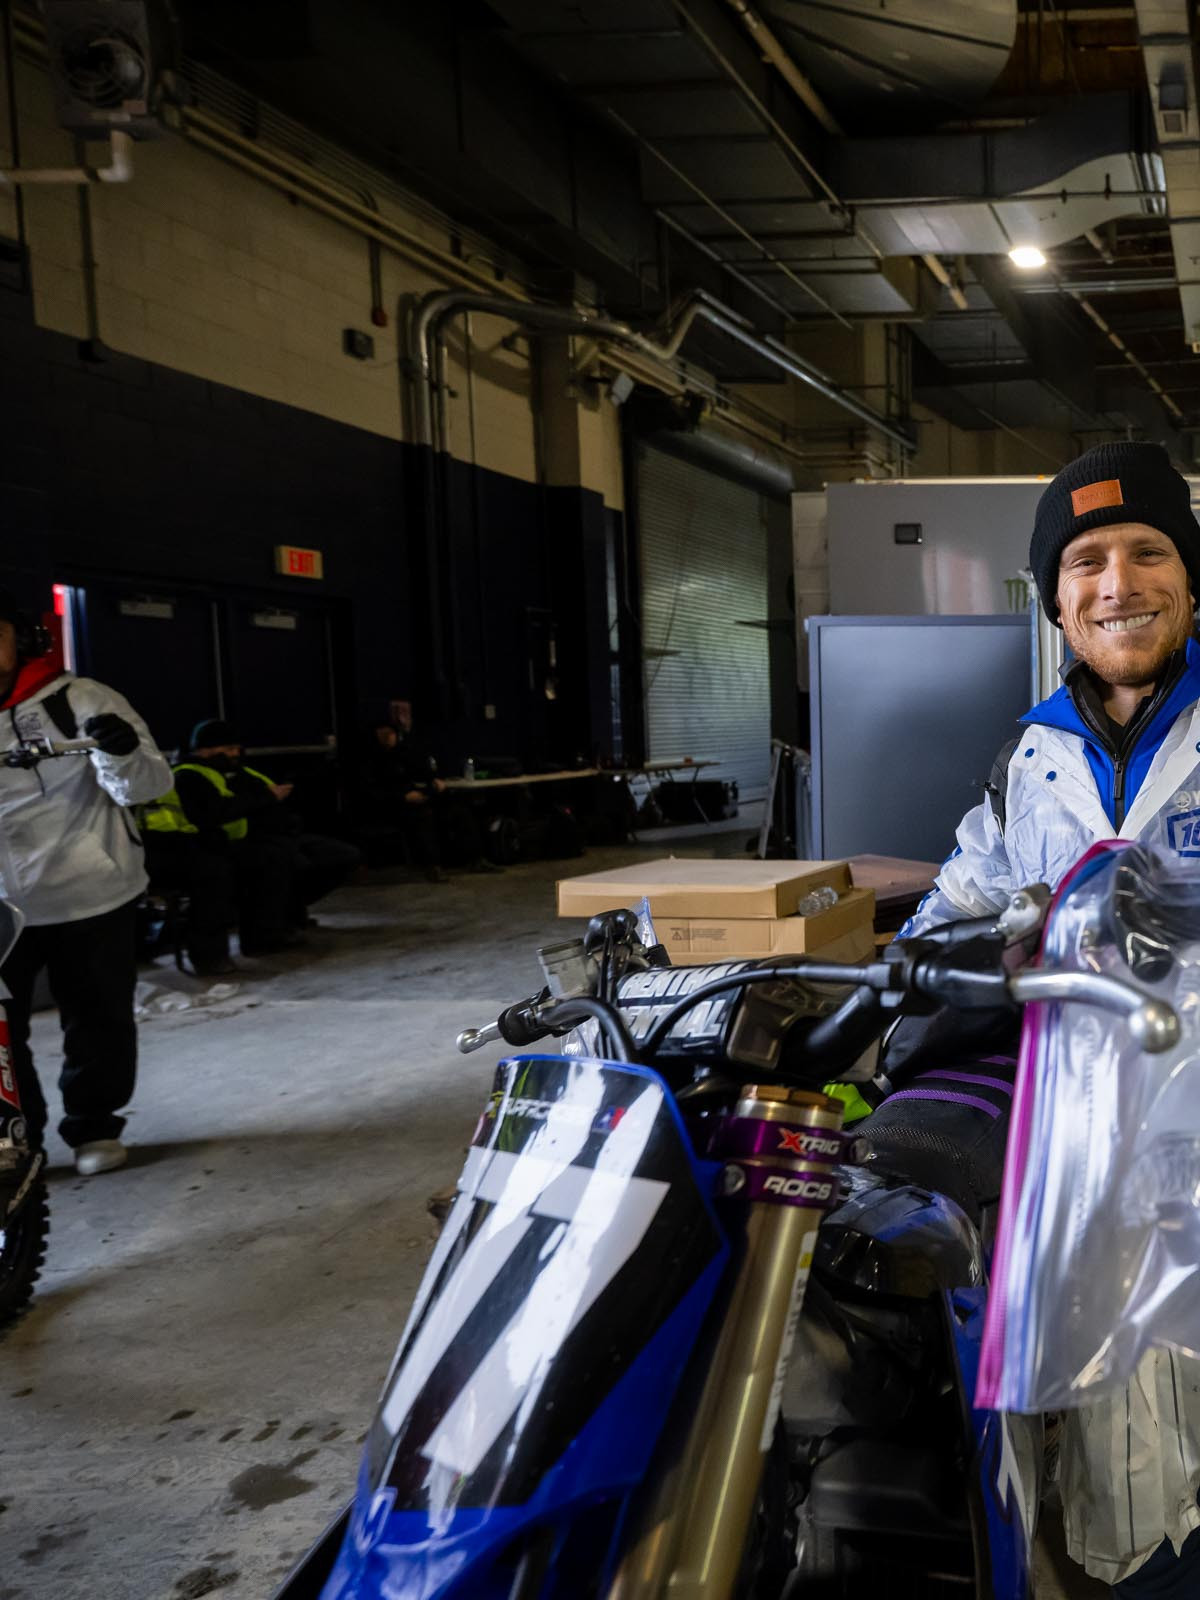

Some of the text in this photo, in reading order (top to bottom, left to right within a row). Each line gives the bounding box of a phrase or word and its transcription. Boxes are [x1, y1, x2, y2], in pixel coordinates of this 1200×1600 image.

[288, 549, 315, 576] EXIT
[777, 1127, 840, 1156] XTRIG
[763, 1175, 833, 1200] ROCS
